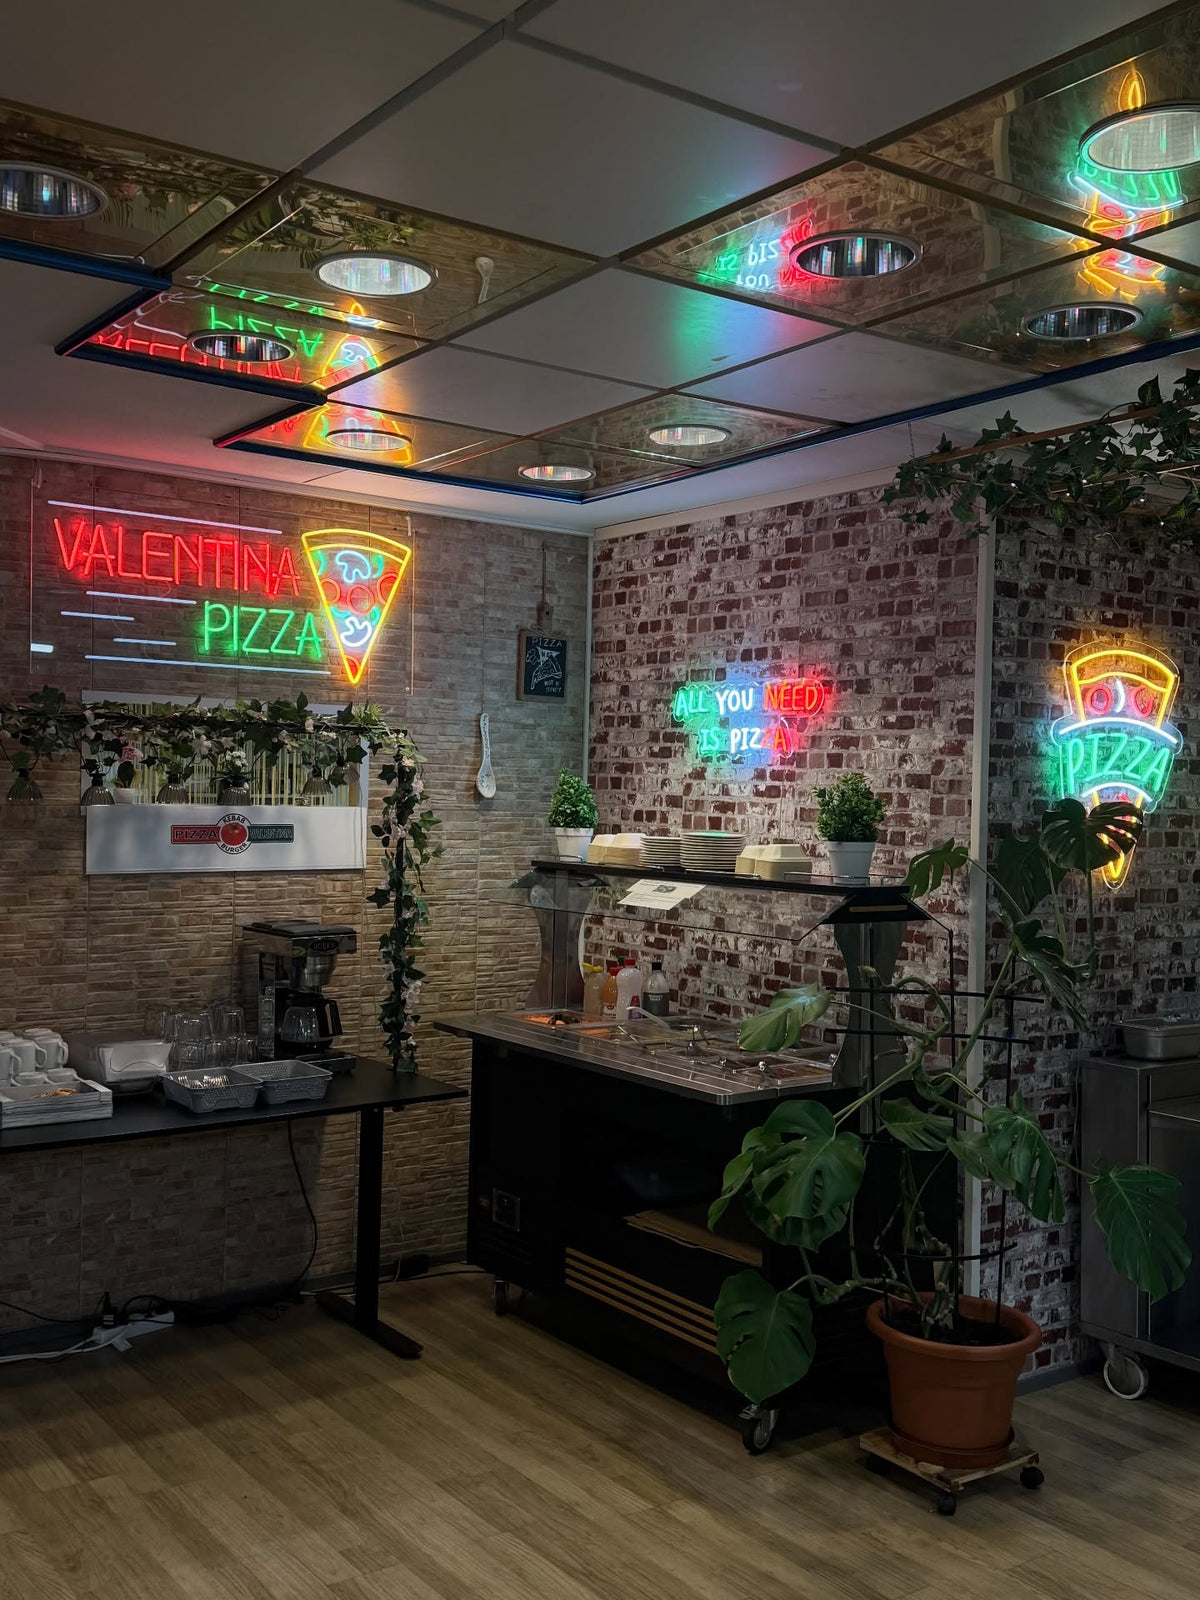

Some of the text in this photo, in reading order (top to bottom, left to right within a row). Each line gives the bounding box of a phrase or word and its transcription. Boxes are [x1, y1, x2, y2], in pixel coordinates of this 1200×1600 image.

[53, 518, 300, 597] VALENTINA
[203, 600, 323, 658] PIZZA
[531, 636, 563, 647] PIZZA
[675, 680, 818, 717] ALL YOU NEED
[700, 725, 787, 754] IS PIZZA
[1068, 732, 1170, 795] PIZZA
[175, 829, 218, 839] PIZZA
[222, 815, 245, 824] KEBAB
[220, 843, 248, 853] BURGER
